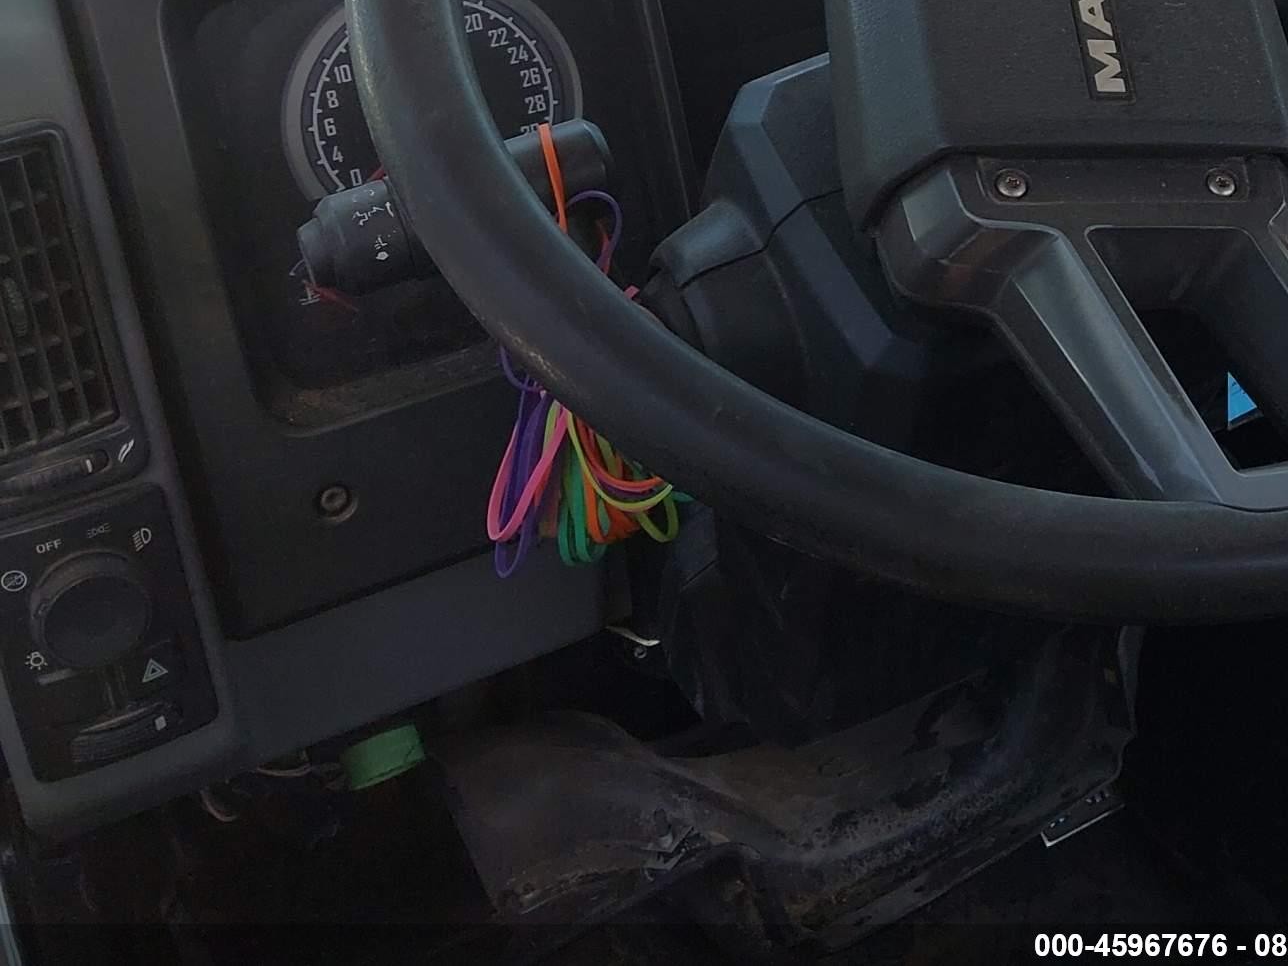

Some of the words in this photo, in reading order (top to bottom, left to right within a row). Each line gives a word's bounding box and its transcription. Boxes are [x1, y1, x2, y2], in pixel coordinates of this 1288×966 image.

[464, 12, 483, 33] 20
[488, 27, 509, 48] 22
[507, 45, 529, 65] 24
[334, 64, 352, 85] 10
[520, 68, 542, 88] 26
[326, 89, 339, 109] 8
[525, 94, 546, 115] 28
[324, 118, 337, 137] 6
[332, 145, 344, 164] 4
[36, 538, 64, 554] OFF
